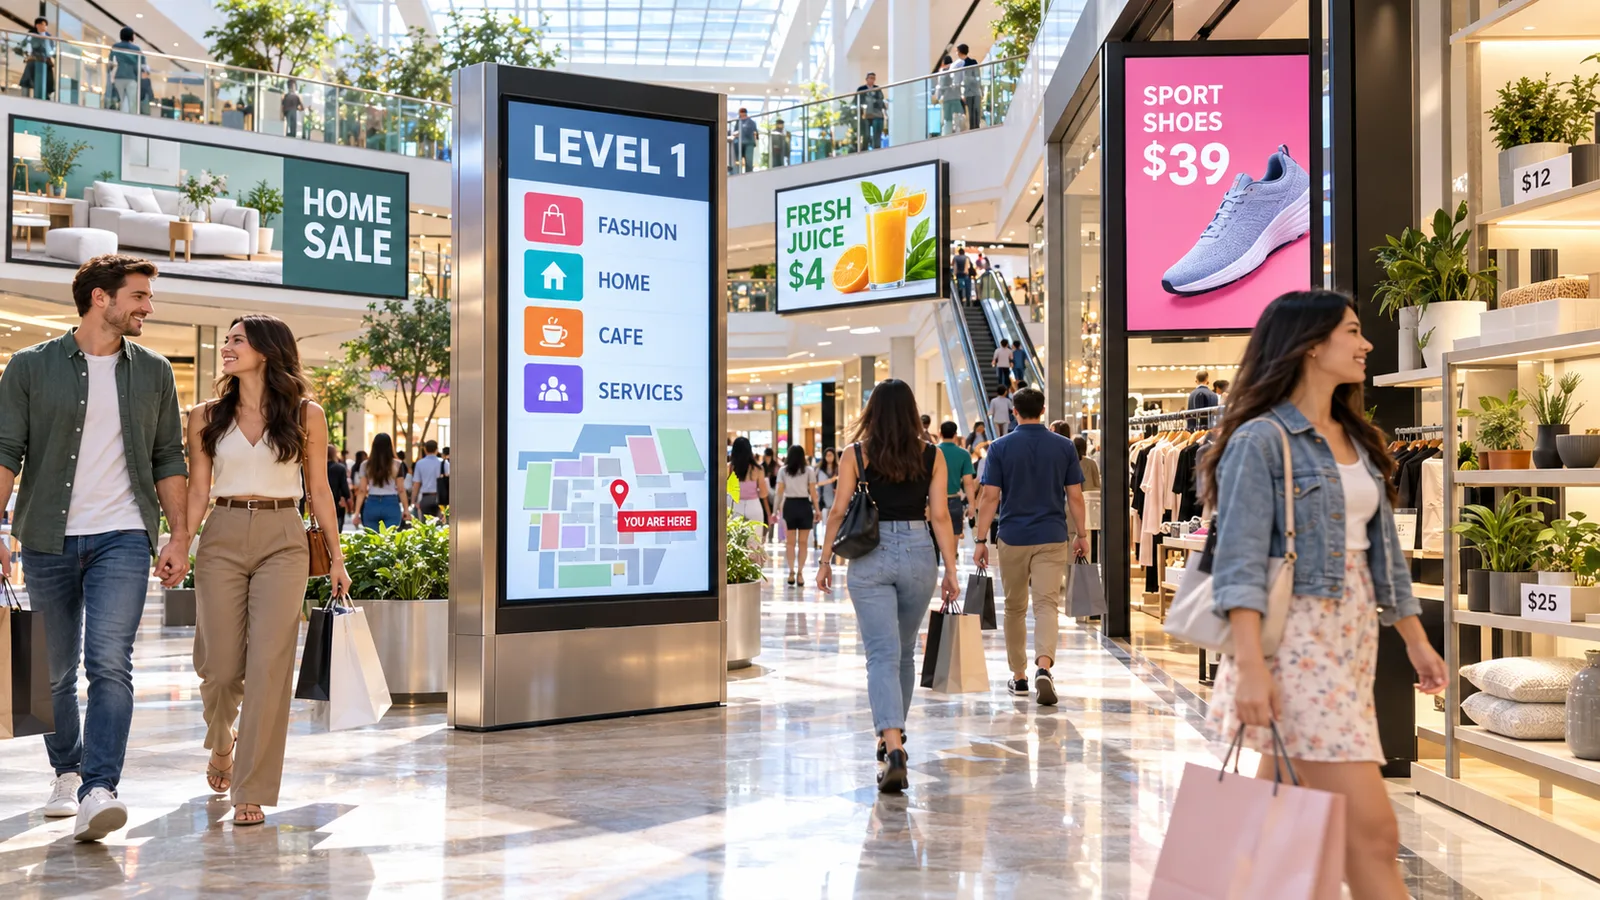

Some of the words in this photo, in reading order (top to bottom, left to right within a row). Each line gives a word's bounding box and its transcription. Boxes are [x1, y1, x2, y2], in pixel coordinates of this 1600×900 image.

[1143, 84, 1224, 106] SPORT
[1143, 111, 1223, 133] SHOES
[534, 124, 661, 175] LEVEL
[671, 143, 686, 178] 1
[1142, 139, 1230, 186] $39
[1521, 167, 1551, 194] $12
[303, 186, 392, 225] HOME
[785, 196, 852, 230] FRESH
[598, 216, 677, 242] FASHION
[786, 225, 845, 255] JUICE
[303, 221, 392, 266] SALE
[598, 271, 651, 292] HOME
[788, 257, 826, 292] $4
[598, 326, 644, 346] CAFE
[598, 381, 684, 402] SERVICES
[624, 516, 645, 527] YOU
[646, 516, 665, 527] ARE
[667, 515, 692, 527] HERE
[1528, 590, 1557, 612] $25
